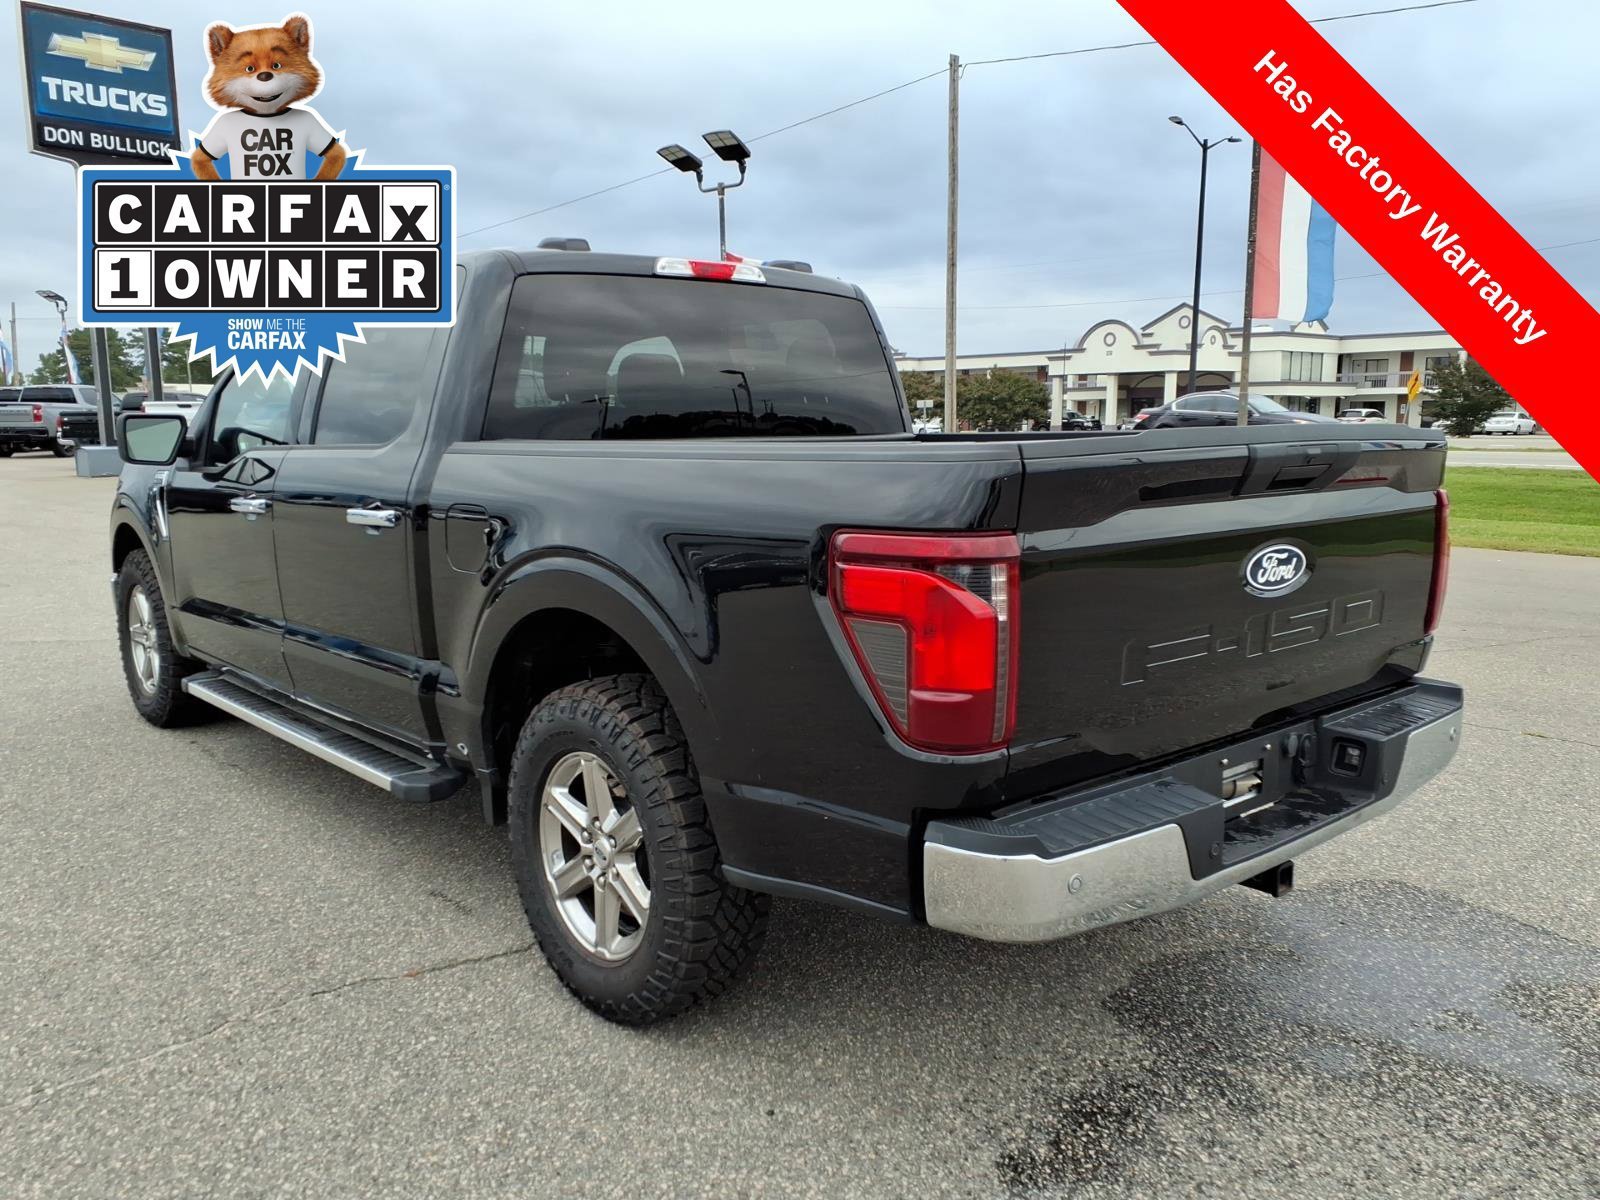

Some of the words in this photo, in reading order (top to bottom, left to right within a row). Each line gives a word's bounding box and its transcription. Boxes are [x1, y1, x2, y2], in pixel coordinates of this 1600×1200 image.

[41, 76, 168, 117] TRUCKS
[44, 126, 84, 146] DON
[90, 132, 172, 157] BULLUCK
[1256, 551, 1297, 584] Ford
[1121, 588, 1386, 686] F-150
